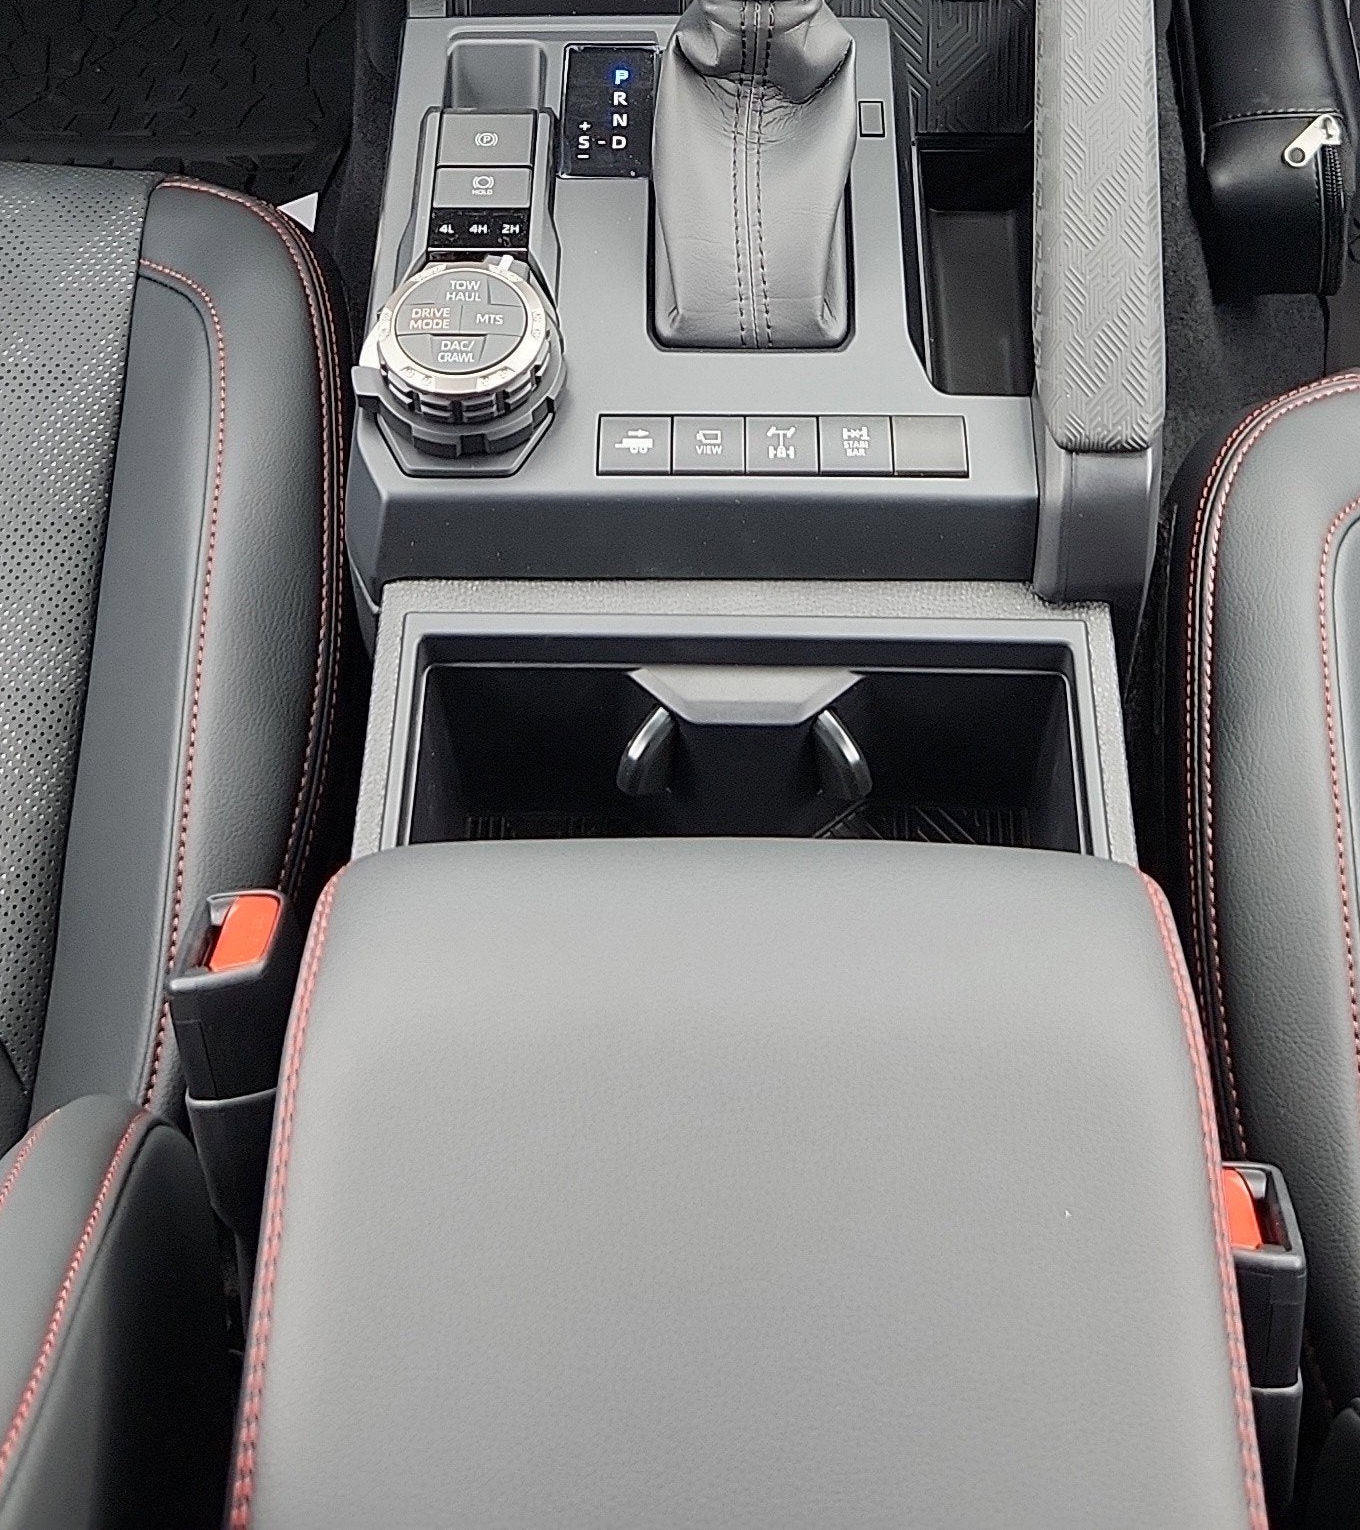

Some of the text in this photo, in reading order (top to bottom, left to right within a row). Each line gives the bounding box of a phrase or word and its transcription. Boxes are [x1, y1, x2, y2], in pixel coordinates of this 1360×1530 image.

[614, 70, 629, 85] P
[613, 91, 628, 106] R
[612, 113, 628, 127] N
[578, 135, 590, 149] S
[611, 135, 627, 149] D
[472, 188, 493, 196] HOLD
[439, 224, 455, 234] 4L
[469, 224, 488, 234] 4H
[501, 224, 520, 234] 2H
[449, 280, 480, 291] TOW
[445, 291, 482, 302] HAUL
[411, 307, 451, 318] DRIVE
[409, 319, 450, 330] MODE
[476, 313, 504, 325] MTS
[440, 340, 474, 351] DAC/
[437, 351, 475, 363] CRAWL
[695, 443, 723, 455] VIEW
[846, 448, 866, 457] BAR
